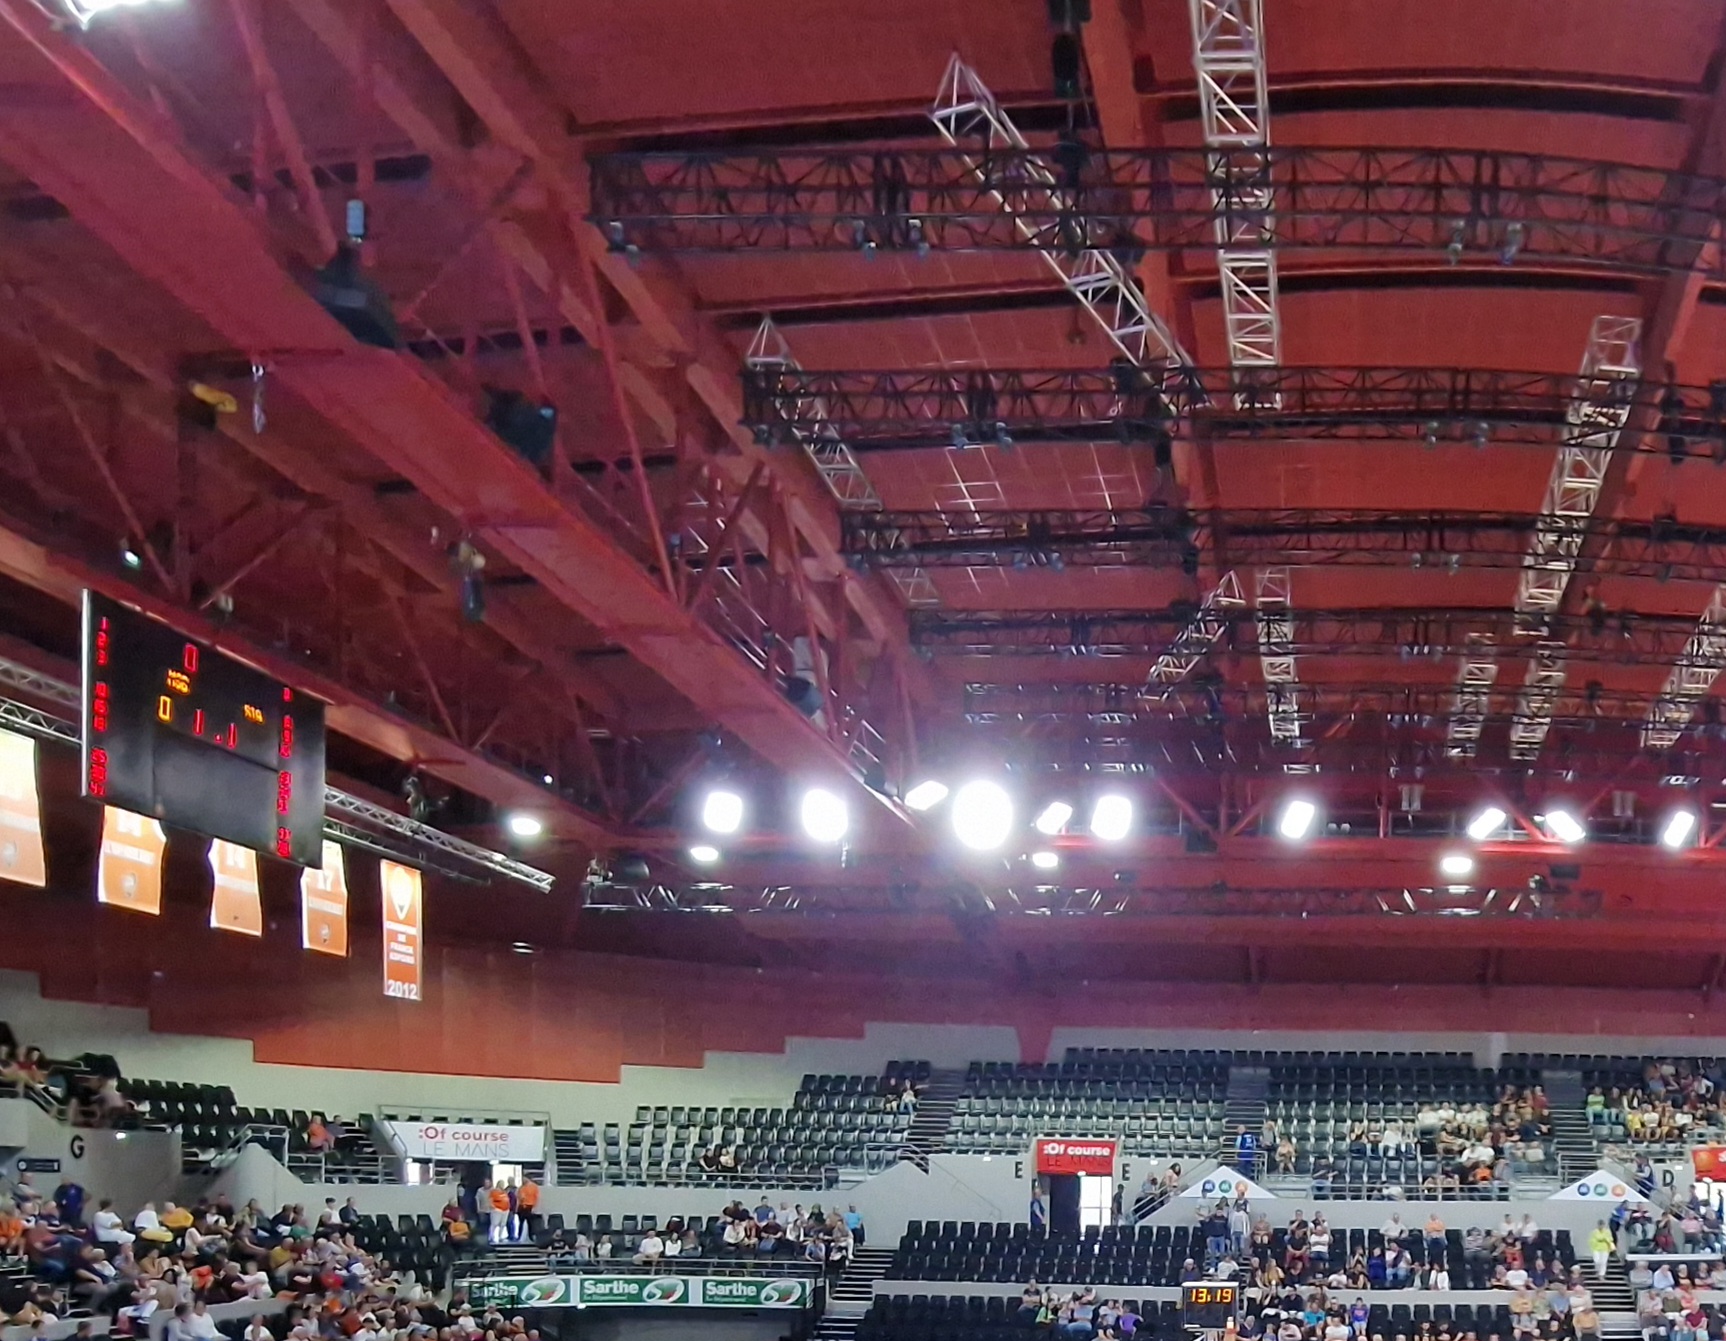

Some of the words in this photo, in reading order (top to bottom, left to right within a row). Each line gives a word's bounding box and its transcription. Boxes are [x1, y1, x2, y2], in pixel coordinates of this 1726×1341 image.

[387, 979, 417, 999] 2012
[451, 1129, 510, 1143] course
[70, 1134, 85, 1159] G
[423, 1141, 443, 1157] LE
[455, 1142, 510, 1158] MANS
[1067, 1145, 1111, 1157] course
[1015, 1160, 1023, 1179] E
[1121, 1162, 1131, 1181] E
[1662, 1169, 1674, 1187] D
[583, 1279, 640, 1296] Sarthe
[706, 1281, 758, 1297] Sarthe
[1191, 1288, 1232, 1303] 13:19
